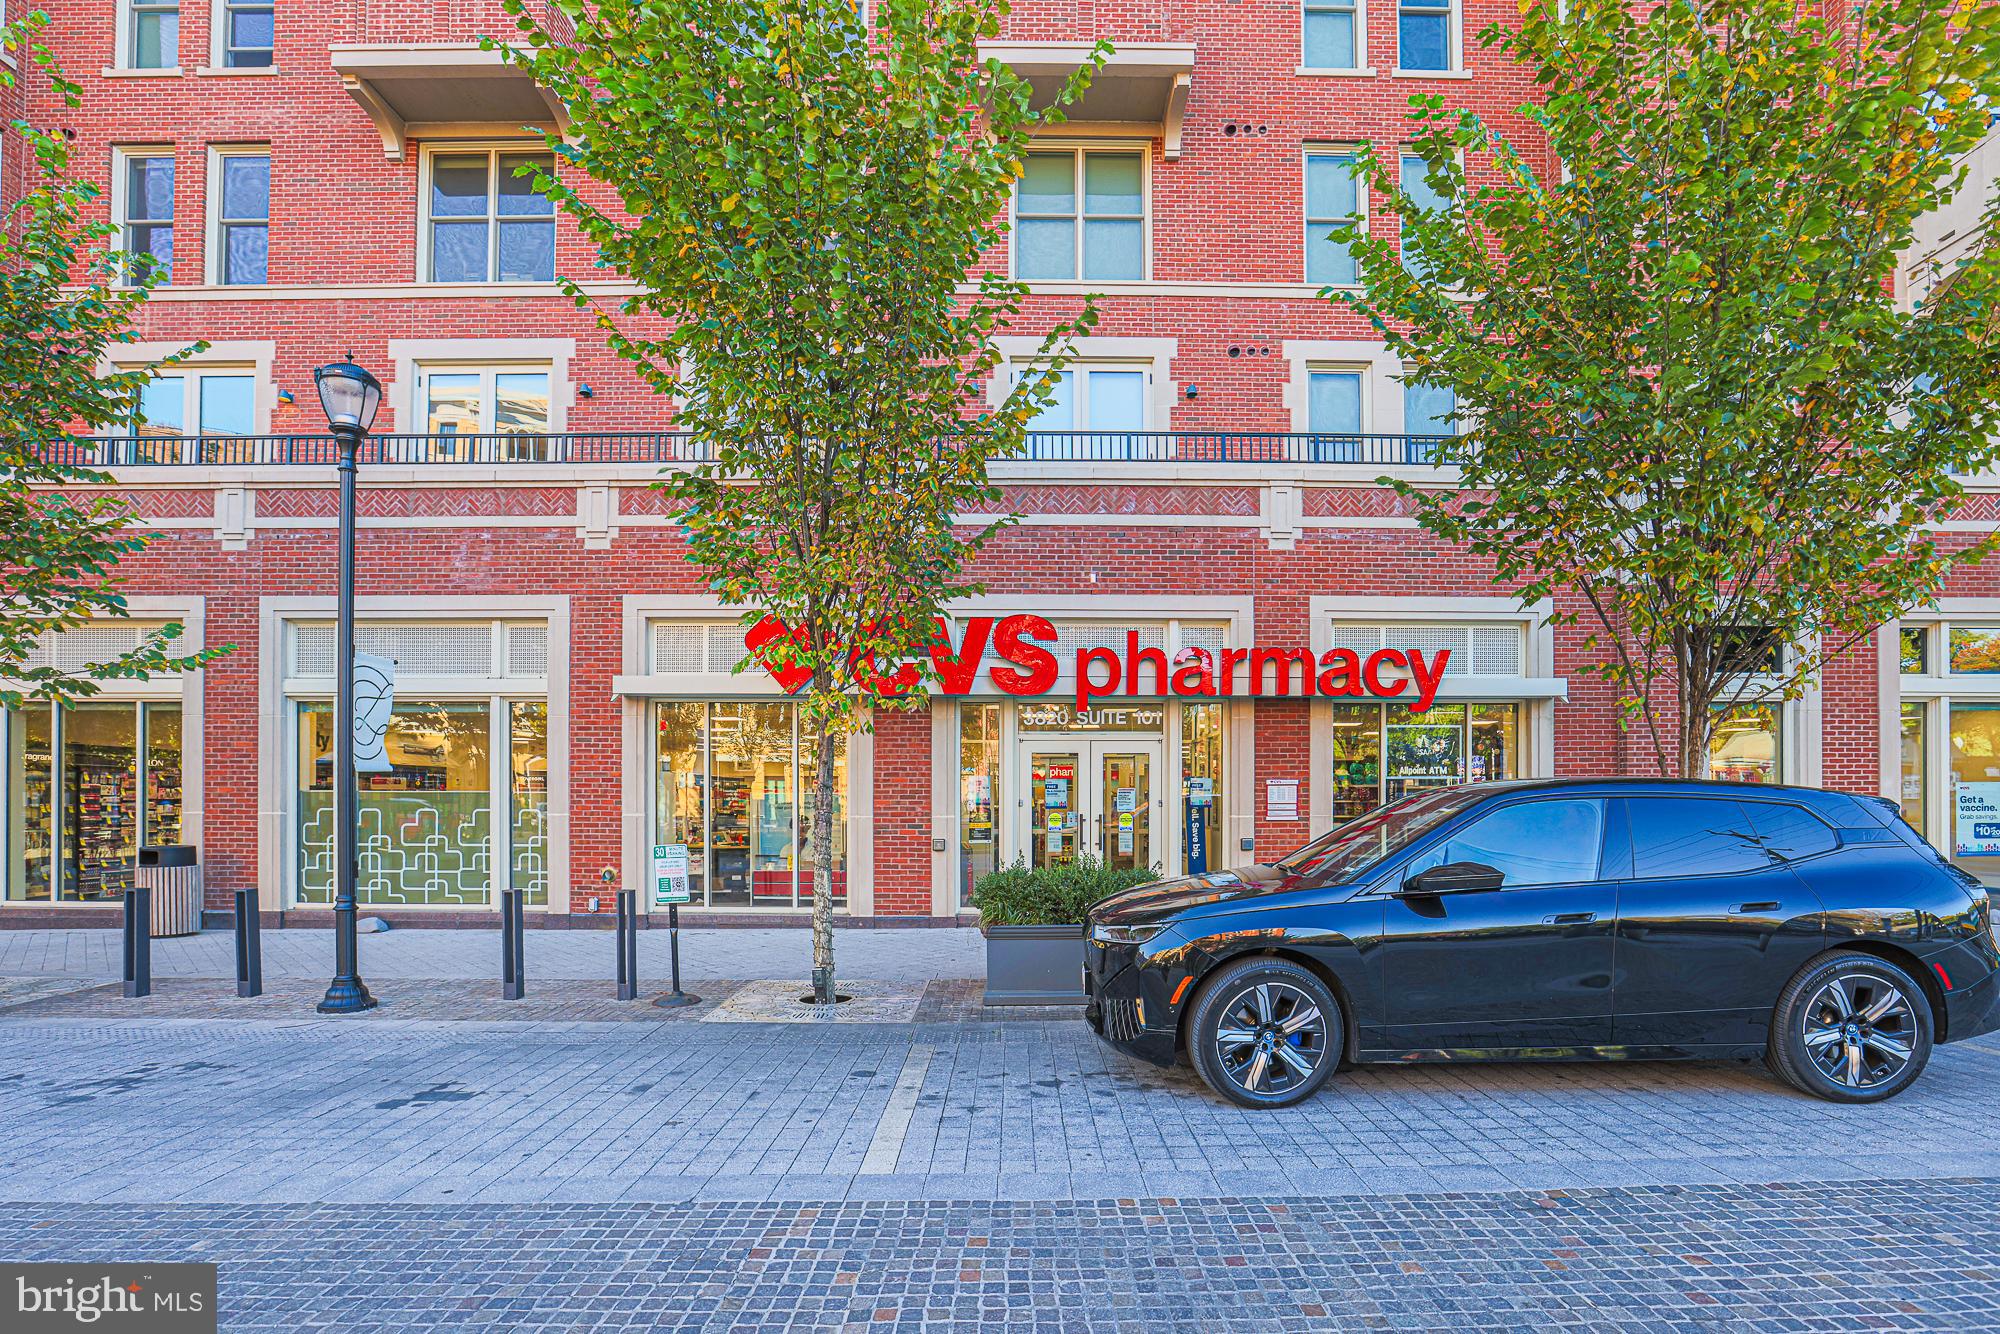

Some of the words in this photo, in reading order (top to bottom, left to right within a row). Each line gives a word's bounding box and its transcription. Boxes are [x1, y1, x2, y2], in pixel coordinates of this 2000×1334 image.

[848, 613, 1059, 697] CVS
[1075, 630, 1452, 713] pharmacy
[1023, 710, 1069, 726] 3820
[1076, 710, 1127, 725] SUITE
[1134, 710, 1162, 725] 101
[1399, 765, 1427, 775] Allpoint
[1429, 766, 1448, 775] ATM
[1960, 795, 1977, 803] Get
[1960, 803, 1998, 812] vaccine.
[1191, 822, 1200, 842] Save
[655, 847, 665, 857] 30
[1191, 843, 1200, 860] big.
